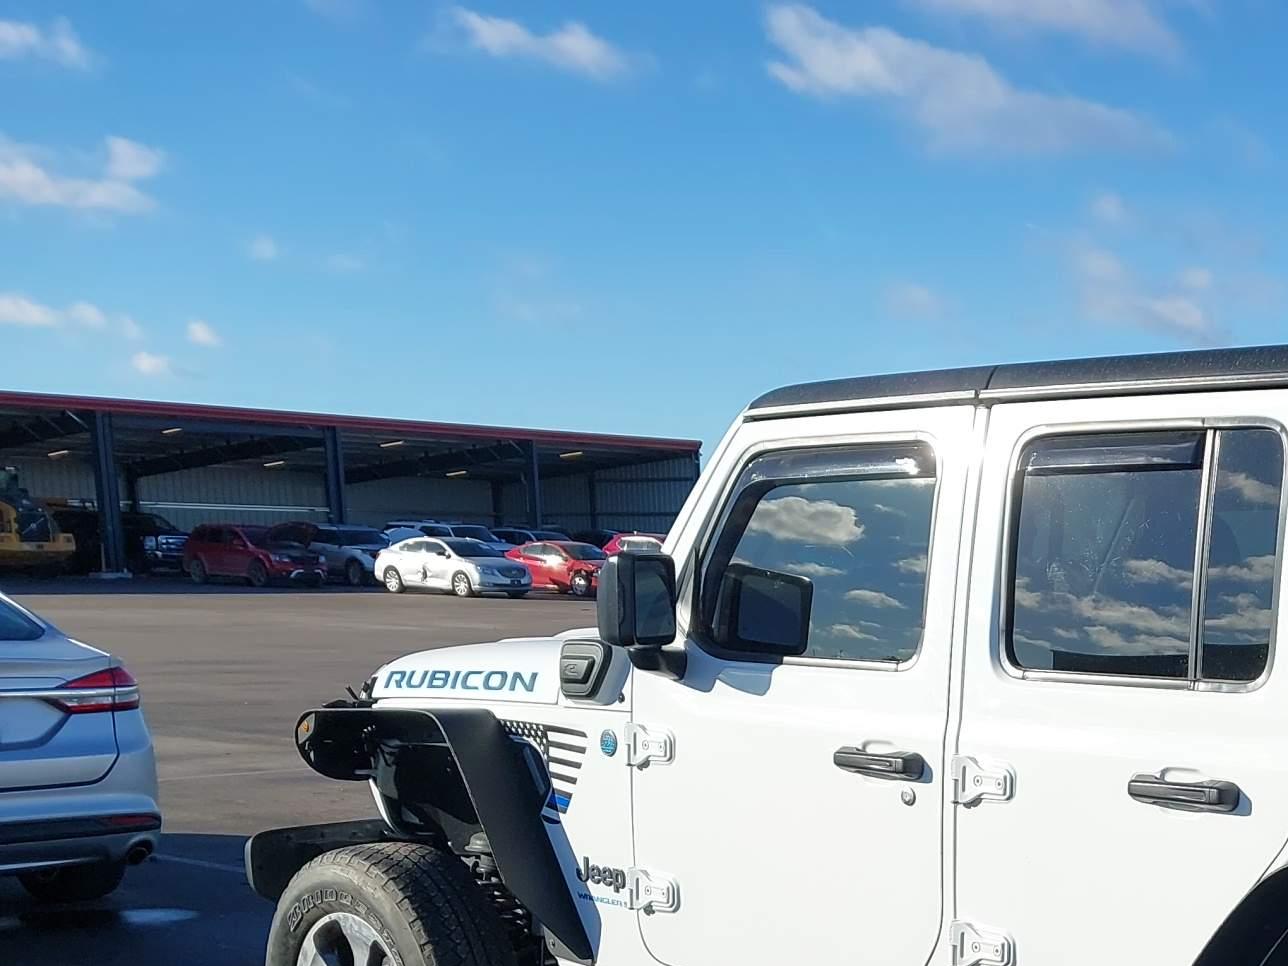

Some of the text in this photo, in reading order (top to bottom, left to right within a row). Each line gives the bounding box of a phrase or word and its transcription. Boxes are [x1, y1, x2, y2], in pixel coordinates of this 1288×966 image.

[384, 669, 538, 692] RUBICON
[576, 856, 627, 893] Jeep
[577, 890, 623, 908] WRANGLER
